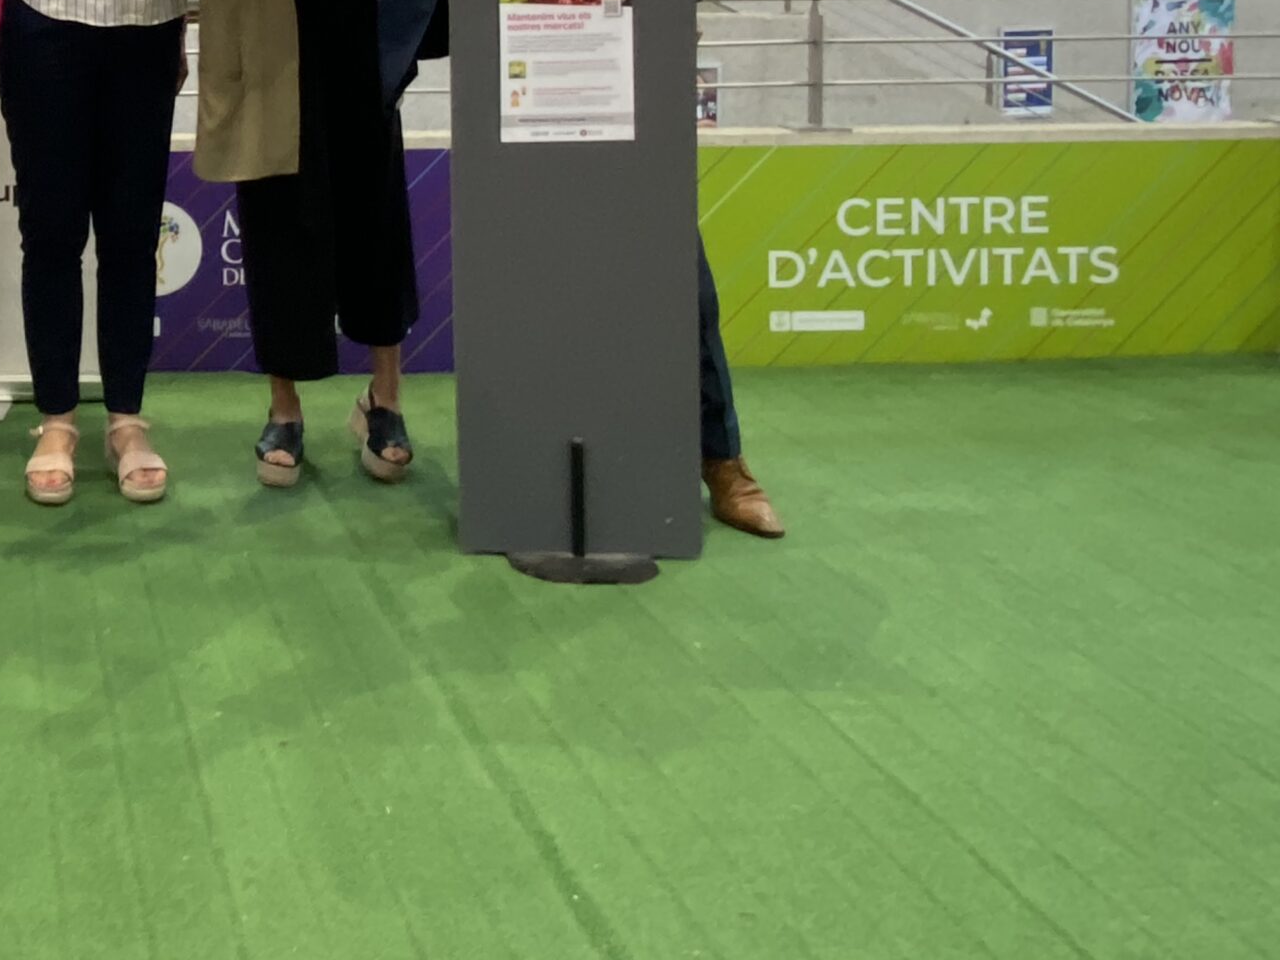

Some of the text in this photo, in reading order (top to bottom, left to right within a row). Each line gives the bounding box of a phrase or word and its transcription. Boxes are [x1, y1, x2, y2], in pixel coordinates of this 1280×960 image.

[1167, 21, 1200, 34] ANY
[1166, 39, 1200, 53] NOU
[836, 195, 1050, 237] CENTRE
